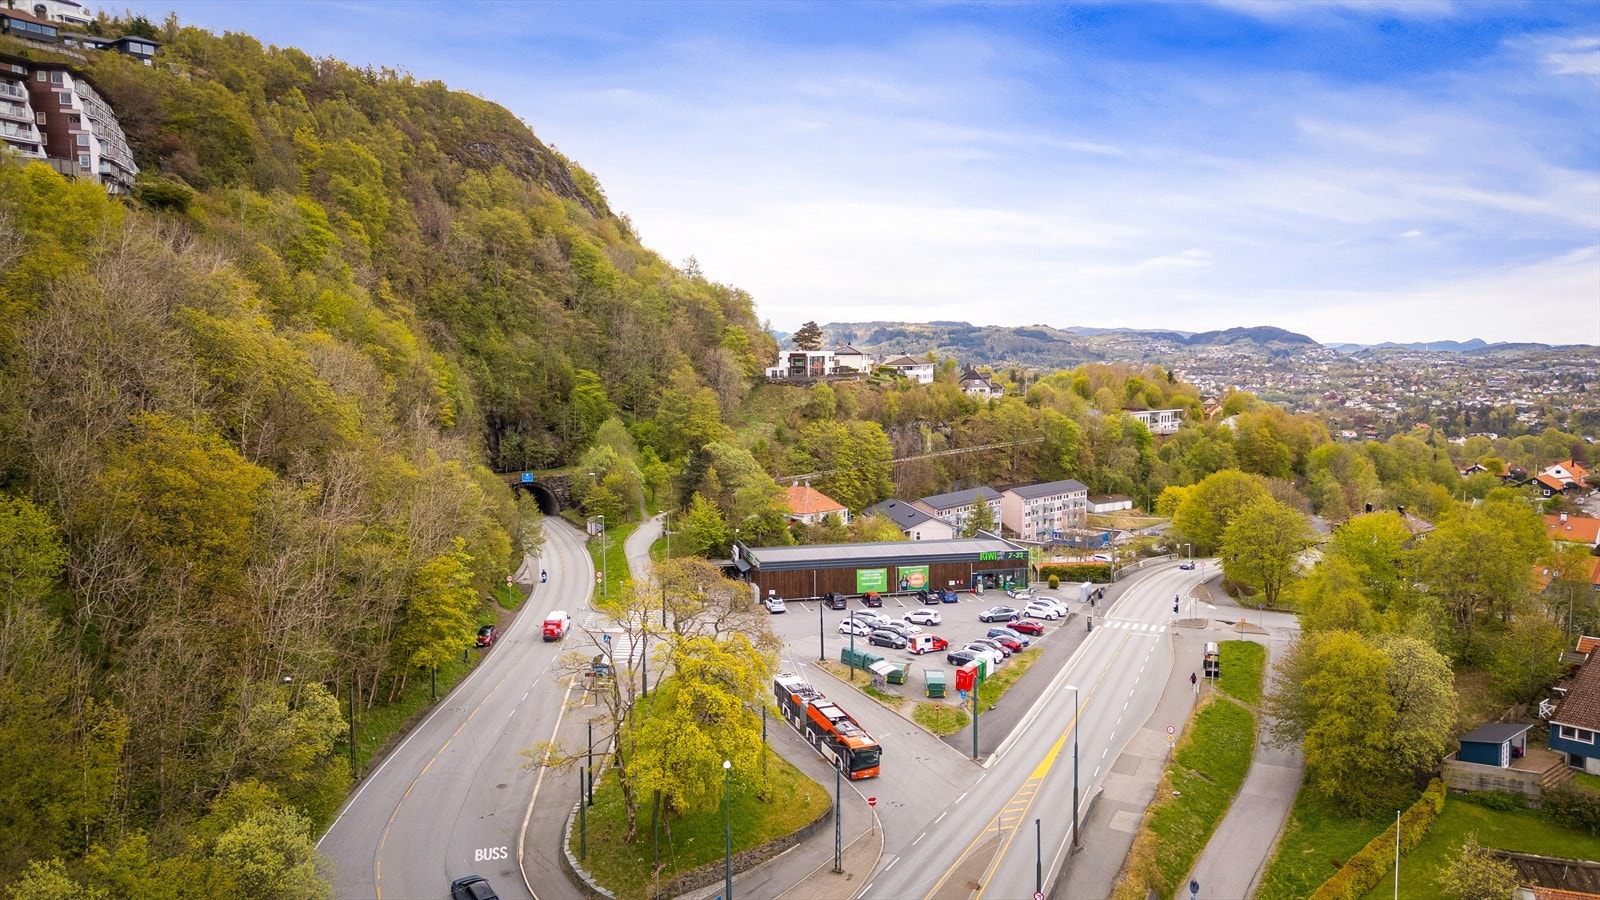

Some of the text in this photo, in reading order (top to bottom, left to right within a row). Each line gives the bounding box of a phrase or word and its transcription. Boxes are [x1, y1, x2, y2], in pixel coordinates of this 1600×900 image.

[979, 551, 997, 561] KIWI
[1008, 551, 1024, 559] 7-23
[474, 846, 508, 862] BUSS
